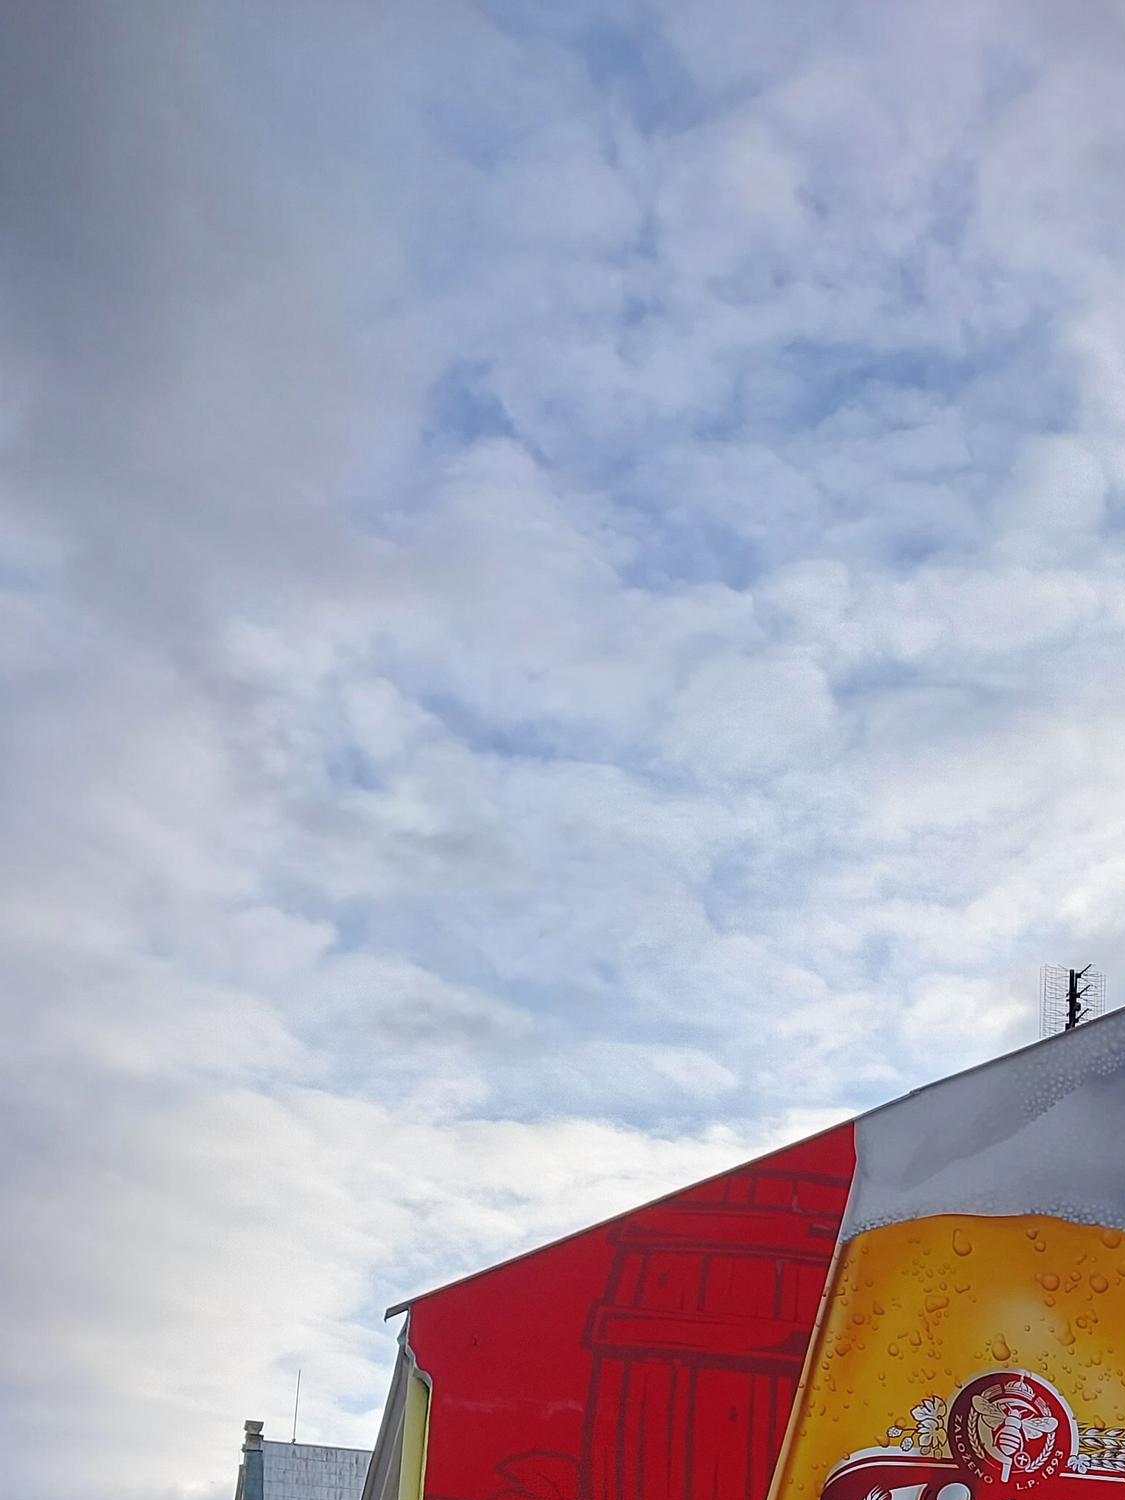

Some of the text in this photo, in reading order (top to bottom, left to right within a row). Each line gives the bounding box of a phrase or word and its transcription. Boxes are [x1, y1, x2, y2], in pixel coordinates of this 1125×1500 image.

[954, 1414, 993, 1484] ZALOŽENO
[1016, 1450, 1064, 1491] L.P. 1893
